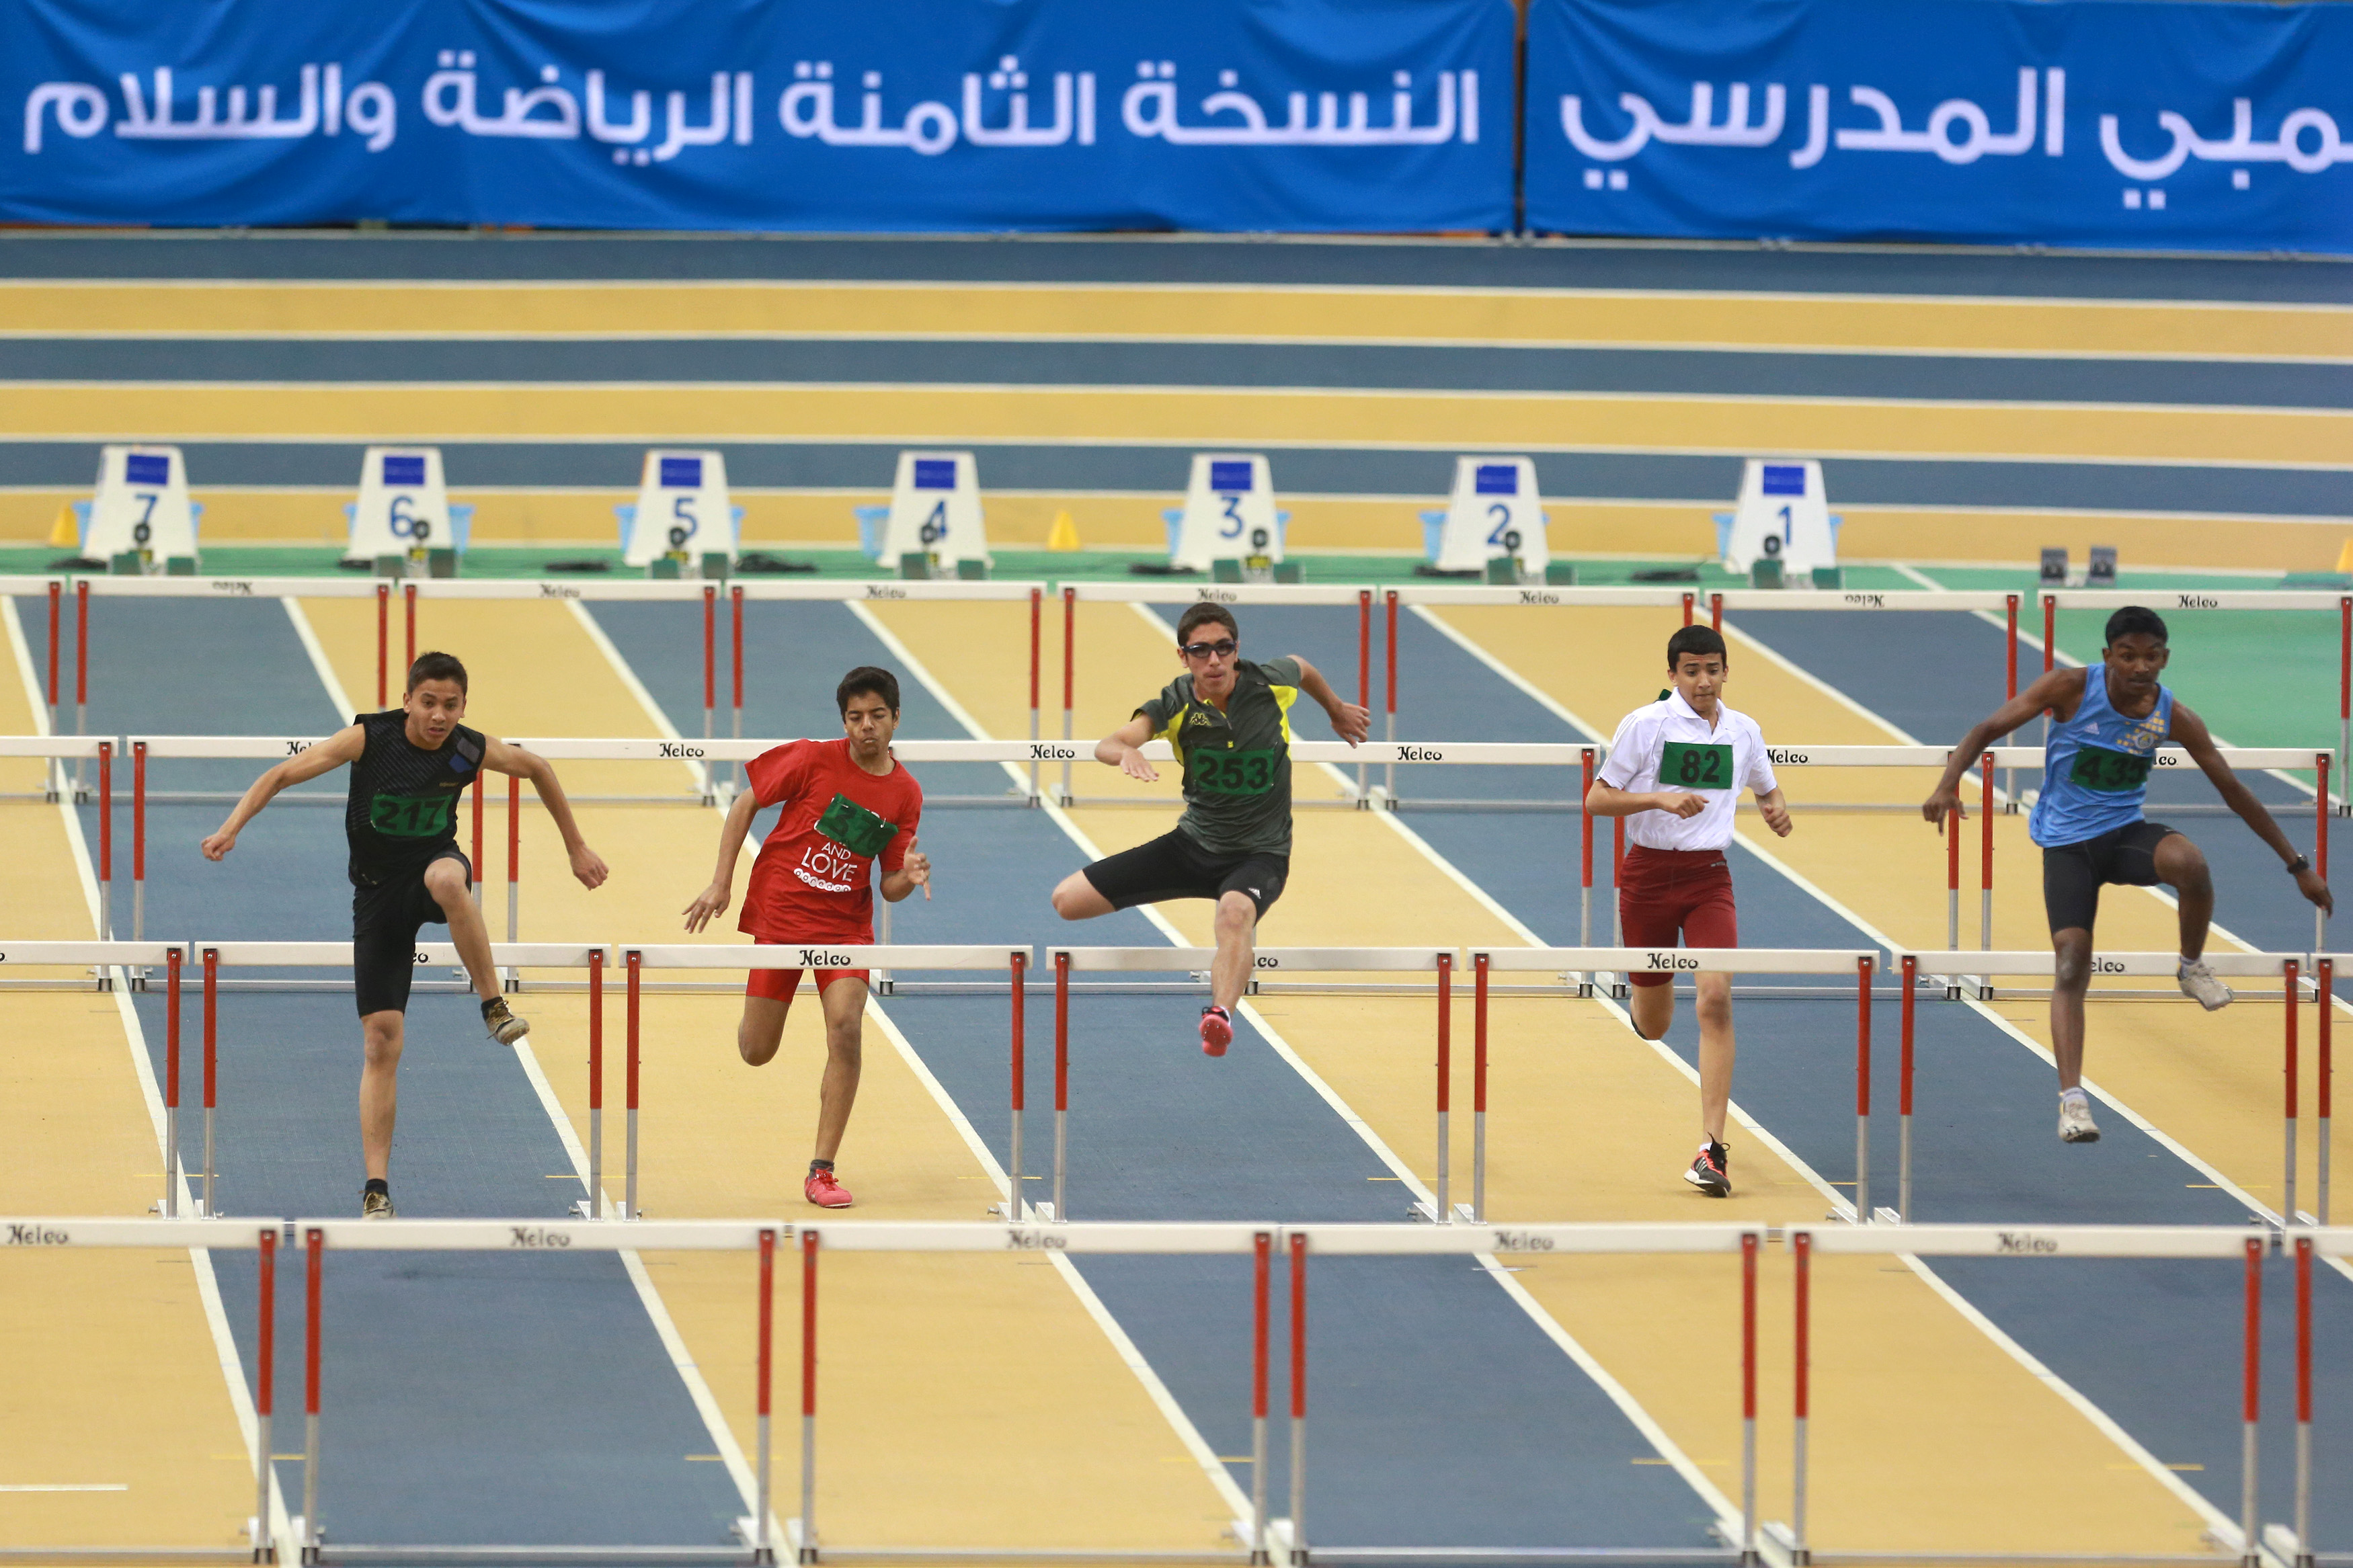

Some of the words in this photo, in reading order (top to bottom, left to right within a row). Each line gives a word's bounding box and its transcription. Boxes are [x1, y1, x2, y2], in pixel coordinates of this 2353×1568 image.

[24, 63, 397, 154] والسلام
[421, 50, 753, 165] الرياضة
[779, 54, 1096, 155] الثامنة
[1122, 60, 1478, 146] النسخة
[1560, 66, 2066, 191] المدرسي
[2100, 97, 2353, 209] مبي
[134, 493, 158, 526] 7
[389, 495, 416, 538] 6
[674, 497, 698, 536] 5
[920, 499, 948, 538] 4
[1220, 497, 1243, 538] 3
[1486, 503, 1510, 544] 2
[1778, 505, 1790, 546] 1
[1520, 591, 1559, 604] Nelco
[1845, 595, 1884, 608] Nelco
[2178, 595, 2218, 608] Nelco
[659, 743, 705, 757] Nelco
[1031, 745, 1075, 759] Nelco
[1397, 747, 1443, 761] Nelco
[1681, 749, 1721, 783] 82
[1767, 749, 1808, 764] Nelco
[1197, 755, 1269, 790] 253
[375, 799, 446, 831] 217
[801, 847, 858, 882] LOVE
[821, 841, 851, 860] AND
[795, 868, 851, 893] ooredoo
[799, 950, 851, 966] Nelco
[1252, 952, 1279, 968] lco
[1647, 953, 1699, 969] Nelco
[2091, 957, 2125, 973] elco
[7, 1224, 69, 1245] Nelco
[510, 1227, 570, 1247] Nelco
